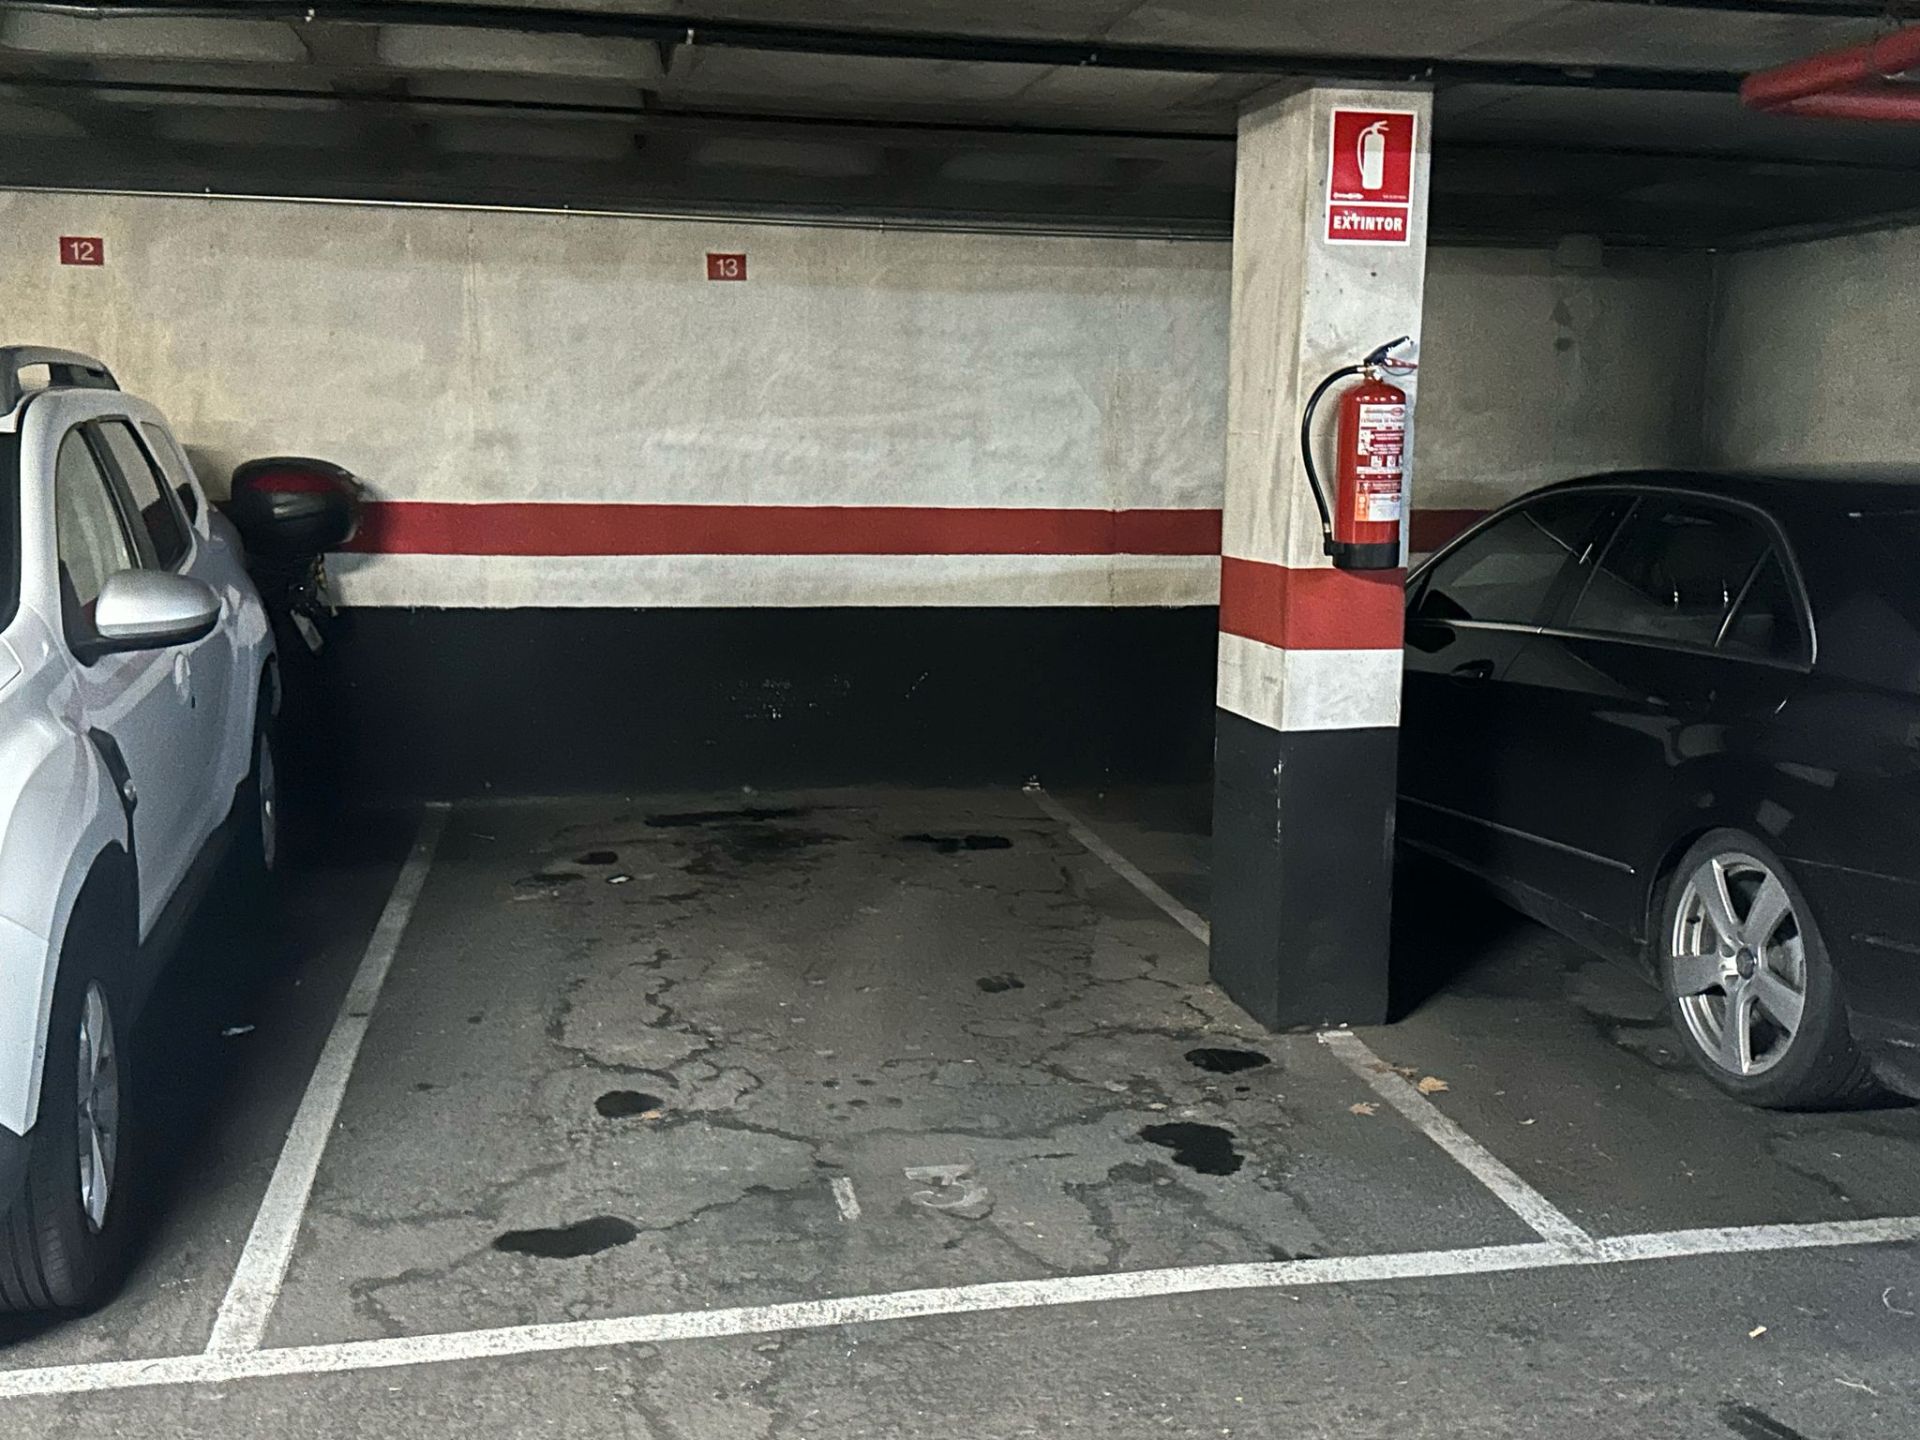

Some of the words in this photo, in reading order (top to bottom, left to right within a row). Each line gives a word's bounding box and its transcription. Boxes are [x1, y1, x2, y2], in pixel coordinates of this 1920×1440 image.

[1333, 215, 1403, 231] EXTINTOR
[69, 242, 95, 261] 12
[716, 258, 738, 277] 13
